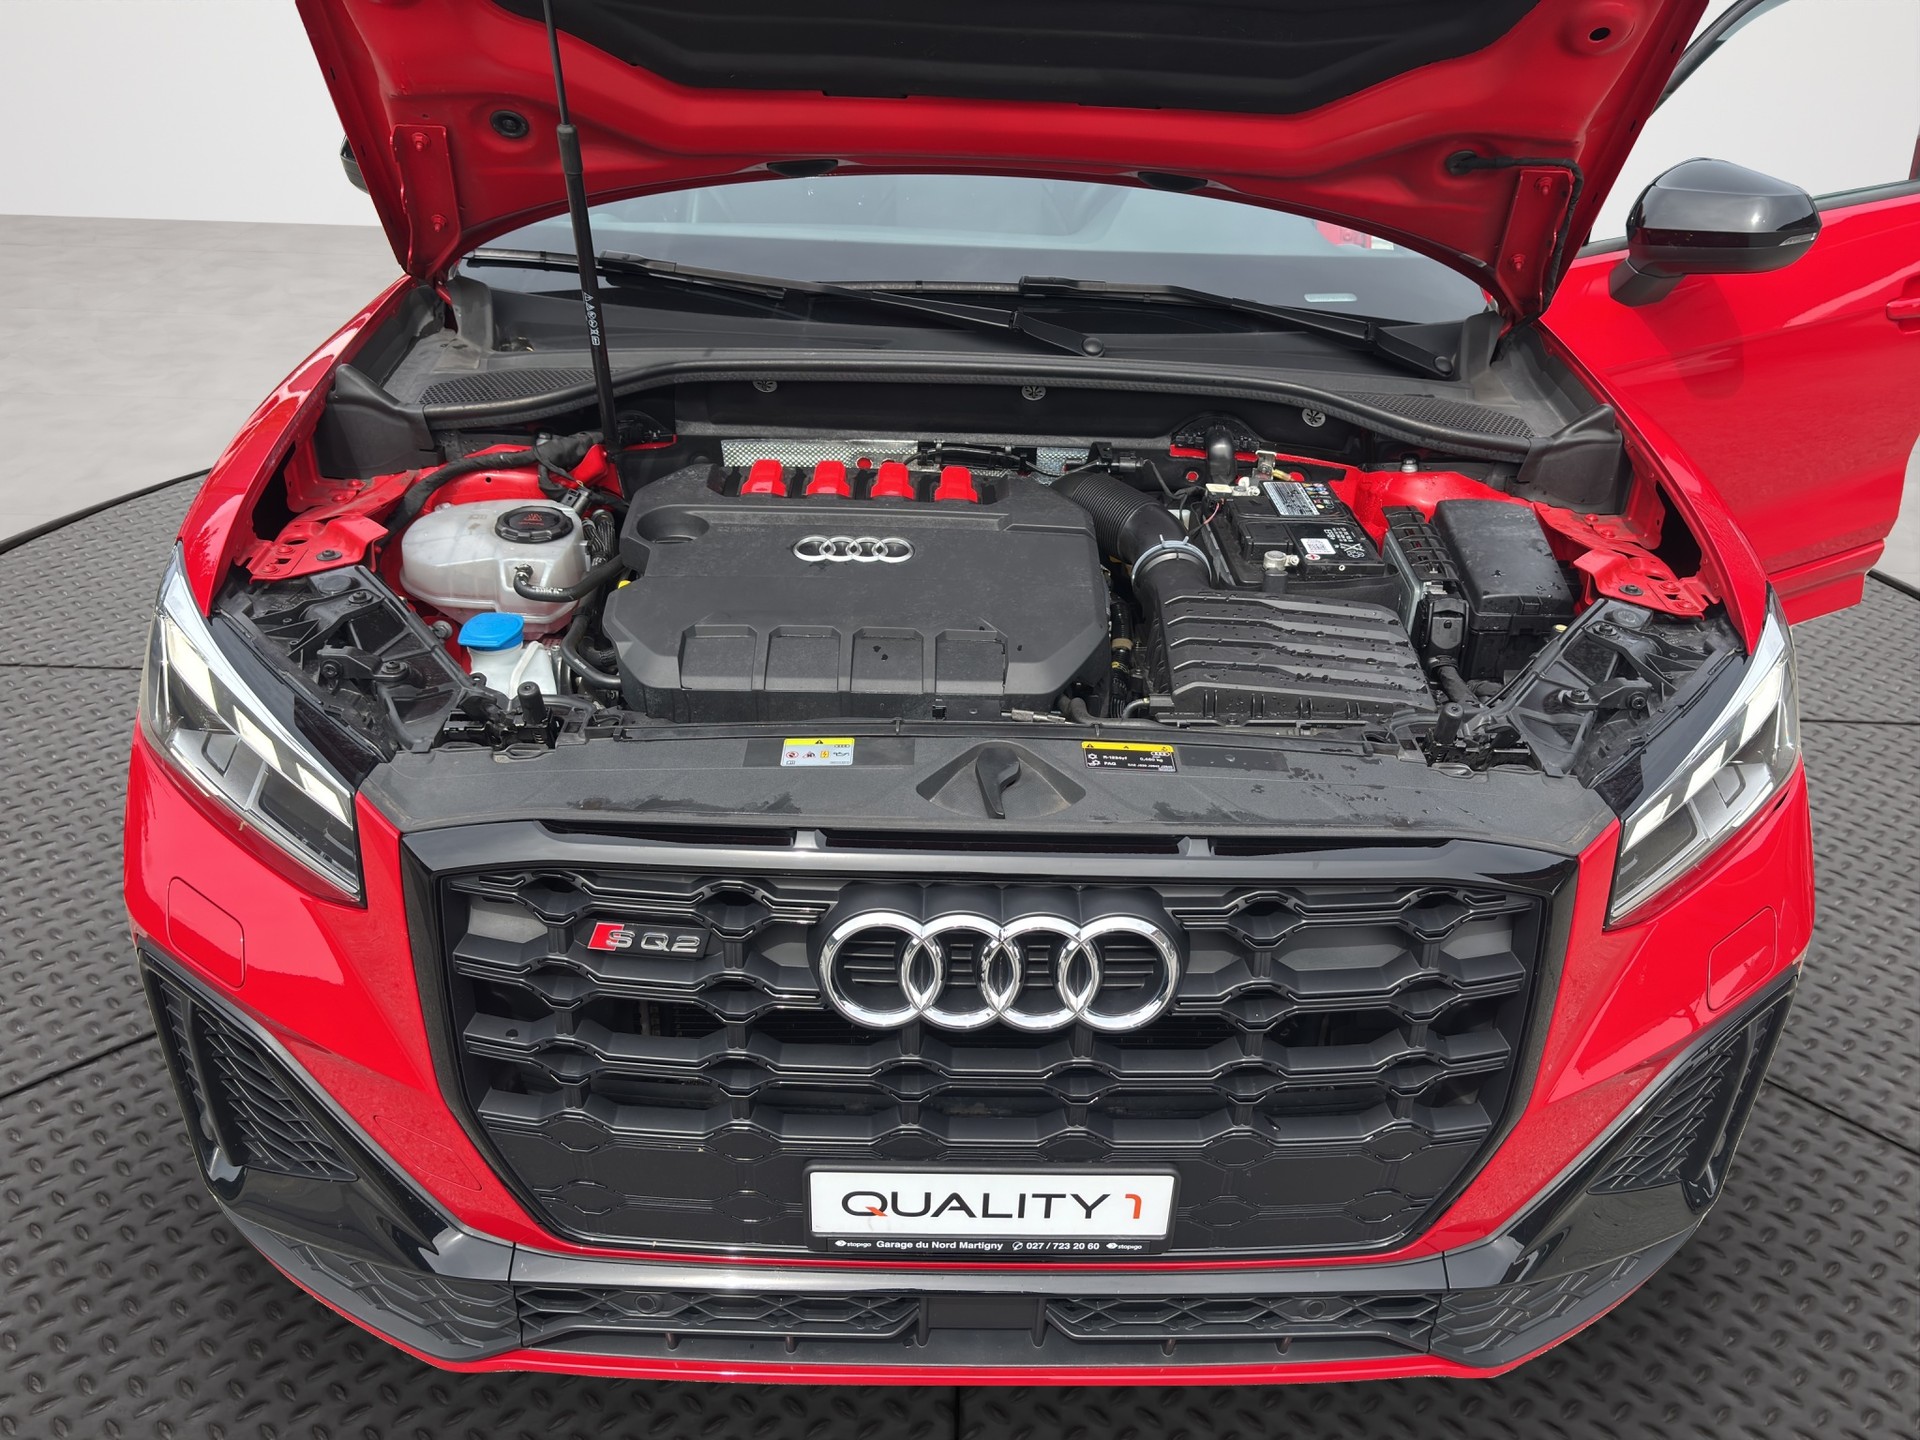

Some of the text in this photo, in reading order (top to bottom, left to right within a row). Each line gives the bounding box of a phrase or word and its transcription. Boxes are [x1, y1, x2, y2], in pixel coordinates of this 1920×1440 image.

[841, 1190, 1111, 1219] QUALITY
[876, 1240, 913, 1250] Garage
[915, 1240, 928, 1249] du
[931, 1241, 958, 1249] Nord
[960, 1241, 1004, 1251] Martigny
